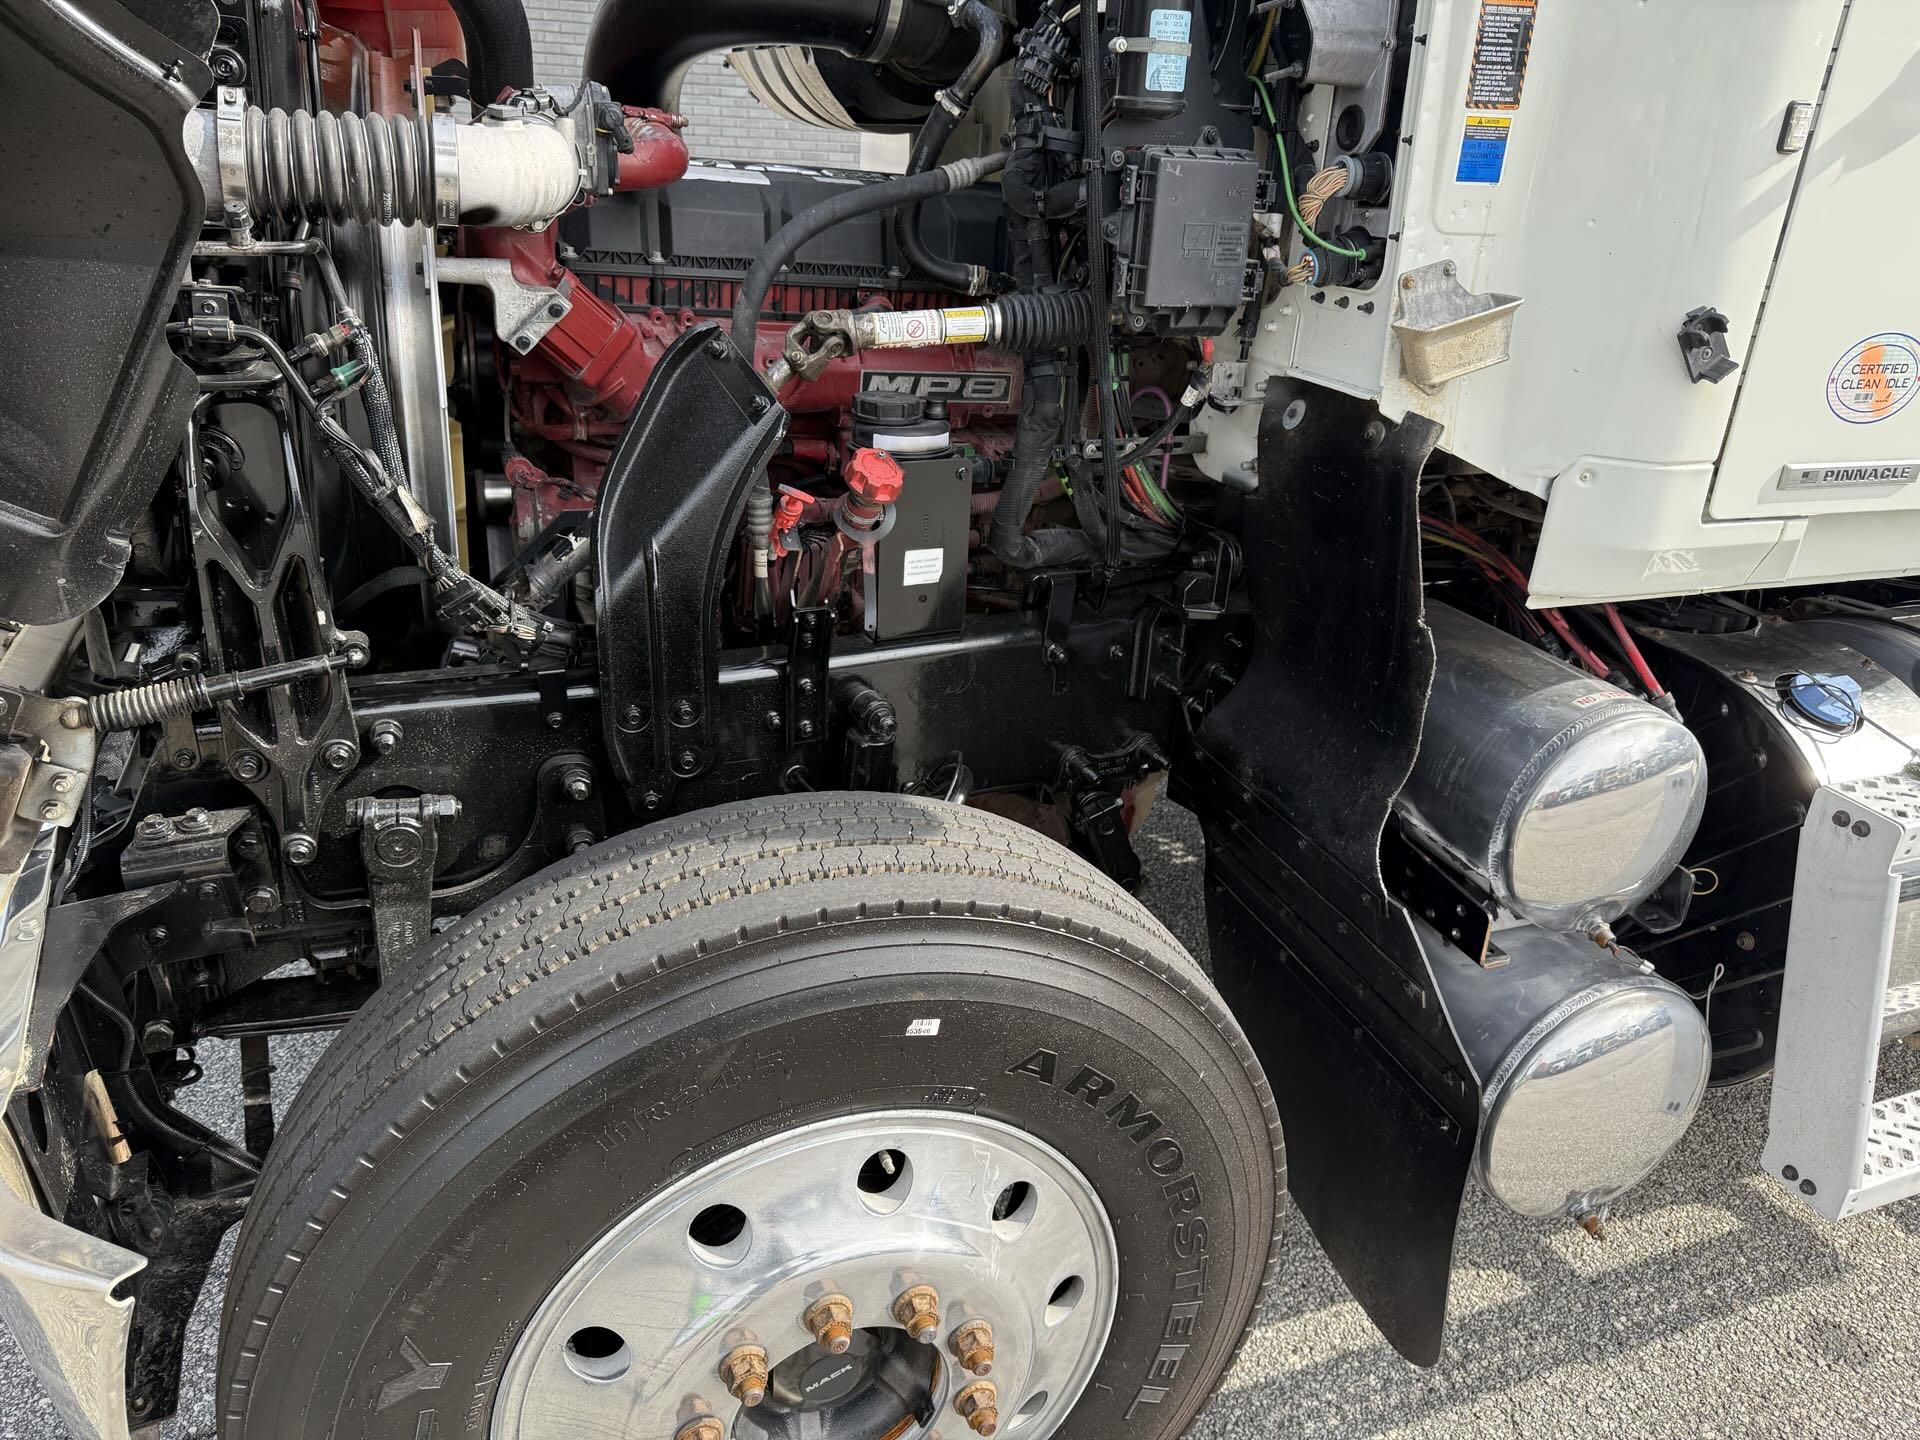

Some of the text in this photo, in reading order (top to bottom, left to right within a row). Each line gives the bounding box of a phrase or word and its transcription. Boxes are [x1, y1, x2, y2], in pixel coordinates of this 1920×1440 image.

[1852, 363, 1909, 374] CERTIFIED
[868, 375, 1007, 398] MP8
[1841, 378, 1910, 390] CLEAN IDLE
[1823, 467, 1911, 482] PINNACLE
[1577, 696, 1595, 705] NO
[1005, 1048, 1209, 1420] ARMORSTEEL
[805, 1363, 853, 1393] MACK
